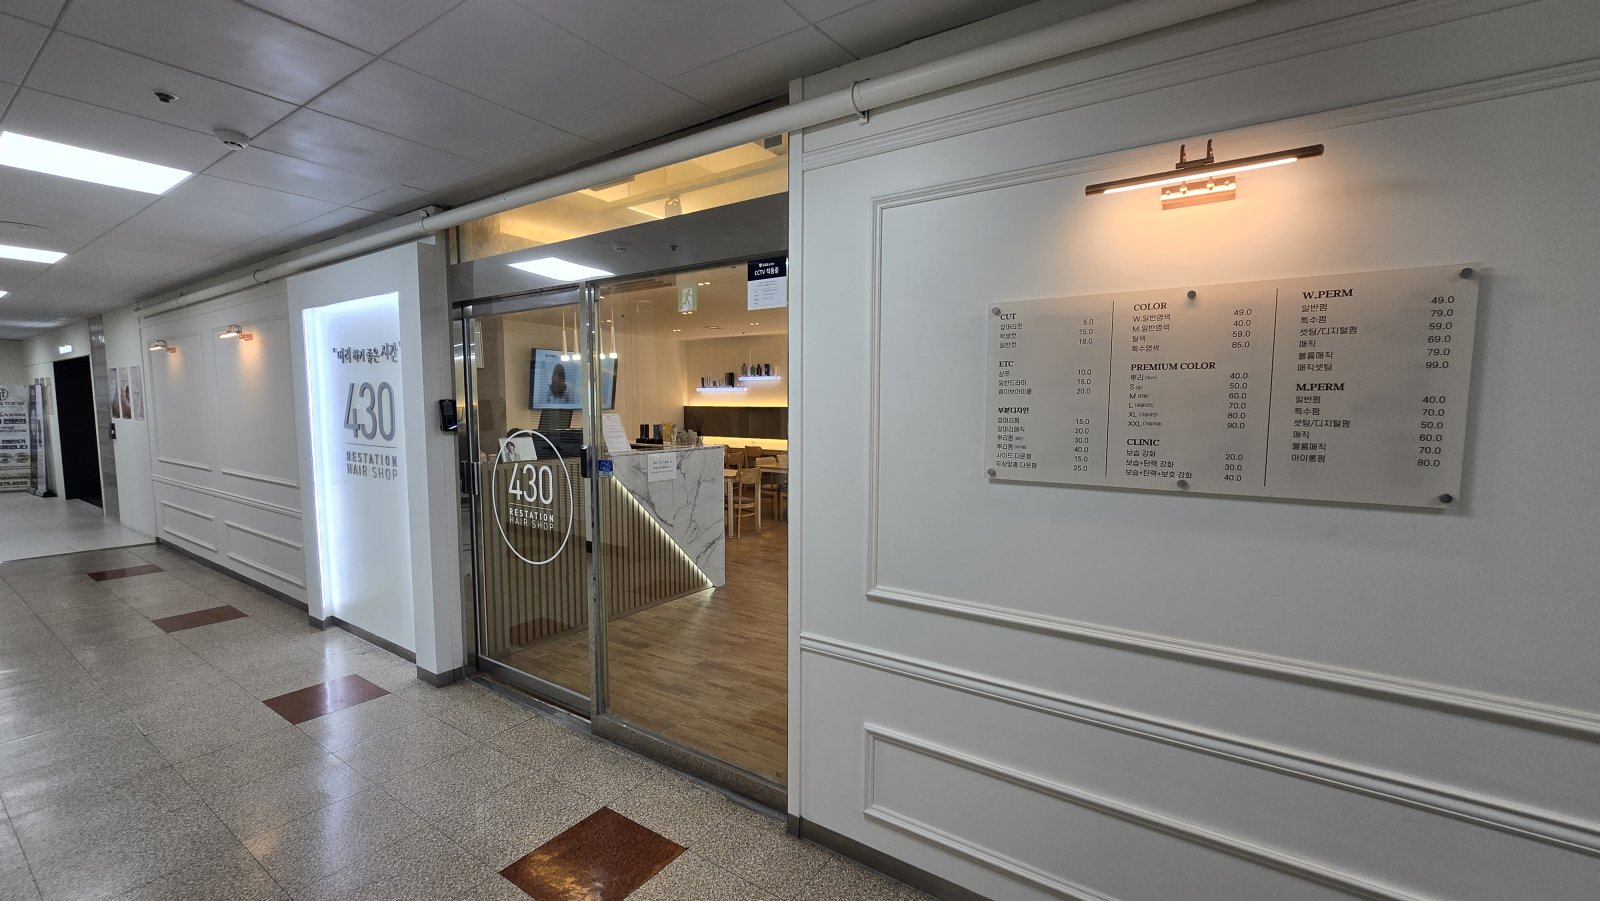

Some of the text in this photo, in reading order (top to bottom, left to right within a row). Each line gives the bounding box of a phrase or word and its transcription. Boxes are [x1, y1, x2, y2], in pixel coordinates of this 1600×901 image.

[1302, 288, 1354, 300] W.PERM
[1134, 302, 1167, 311] COLOR
[1301, 296, 1455, 312] 일반펌 49.0
[1132, 314, 1170, 322] W.일반염색
[1300, 308, 1454, 324] 특수펌 79.0
[1132, 324, 1170, 332] M.일반염색
[1300, 322, 1452, 336] 셋팅/디지털펌 59.0
[1299, 335, 1451, 348] 매직 69.0
[352, 348, 366, 362] 하기
[366, 347, 380, 364] 좋은
[1426, 348, 1450, 356] 79.0
[1130, 362, 1216, 371] PREMIUM COLOR
[1297, 360, 1449, 372] 매직셋팅 99.0
[1296, 382, 1345, 391] M.PERM
[1295, 395, 1446, 404] 일반펌 40.0
[344, 382, 396, 441] 430
[1294, 407, 1445, 416] 특수펌 70.0
[1294, 419, 1444, 429] 셋팅/디지털펌 50.0
[1126, 438, 1160, 446] CLINIC
[1292, 430, 1442, 442] 매직 60.0
[1418, 446, 1442, 455] 70.0
[346, 450, 398, 468] RESTATION
[1292, 454, 1440, 467] 아이롱펌 80.0
[346, 464, 398, 480] HAIR SHOP
[1125, 469, 1175, 478] 보습+탄력+보호
[1178, 471, 1192, 479] 강화
[508, 463, 553, 504] 430
[509, 508, 554, 522] RESTATION
[509, 516, 554, 532] HAIR SHOP
